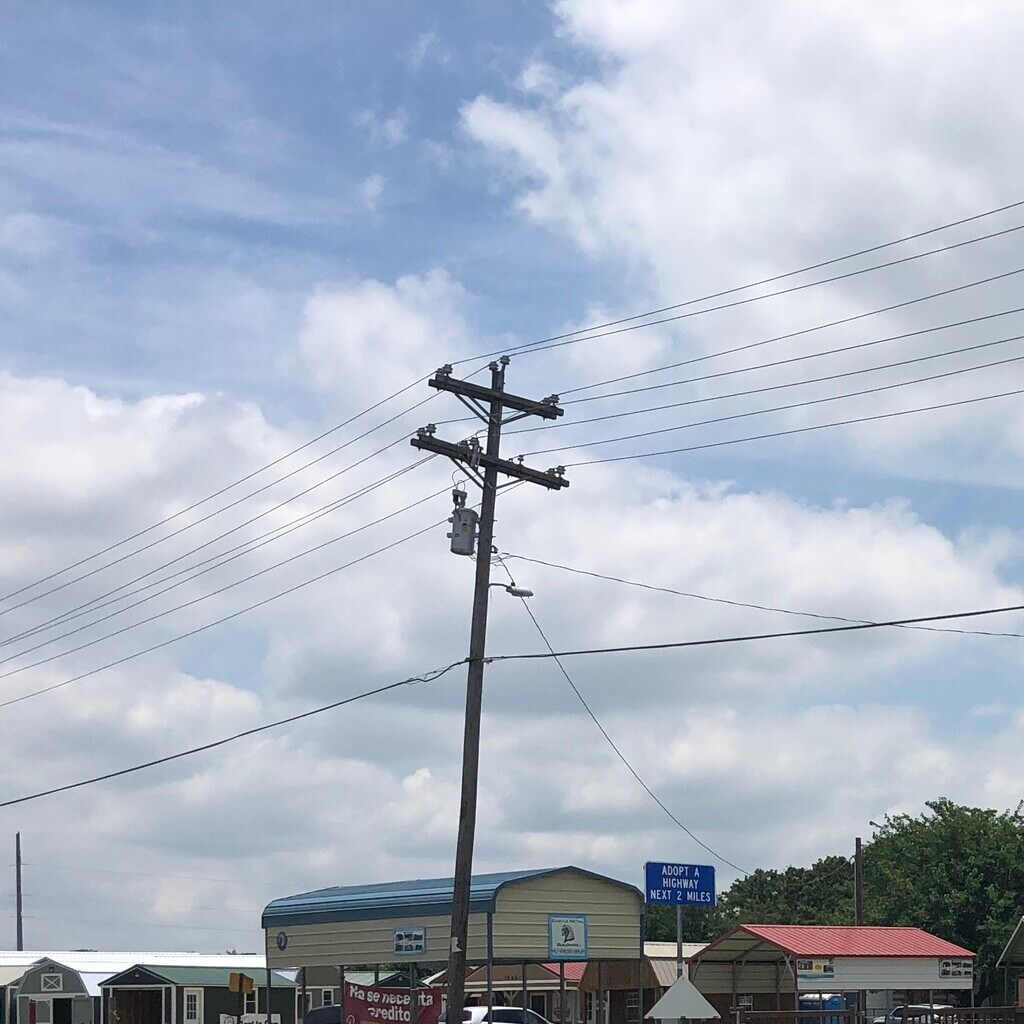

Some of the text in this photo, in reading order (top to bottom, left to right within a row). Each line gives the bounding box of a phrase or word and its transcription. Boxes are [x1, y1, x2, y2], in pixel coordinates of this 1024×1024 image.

[662, 865, 700, 877] ADOPT A
[662, 877, 699, 889] HIGHWAY
[650, 889, 711, 902] NEXT 2 MILES
[366, 990, 381, 1003] se
